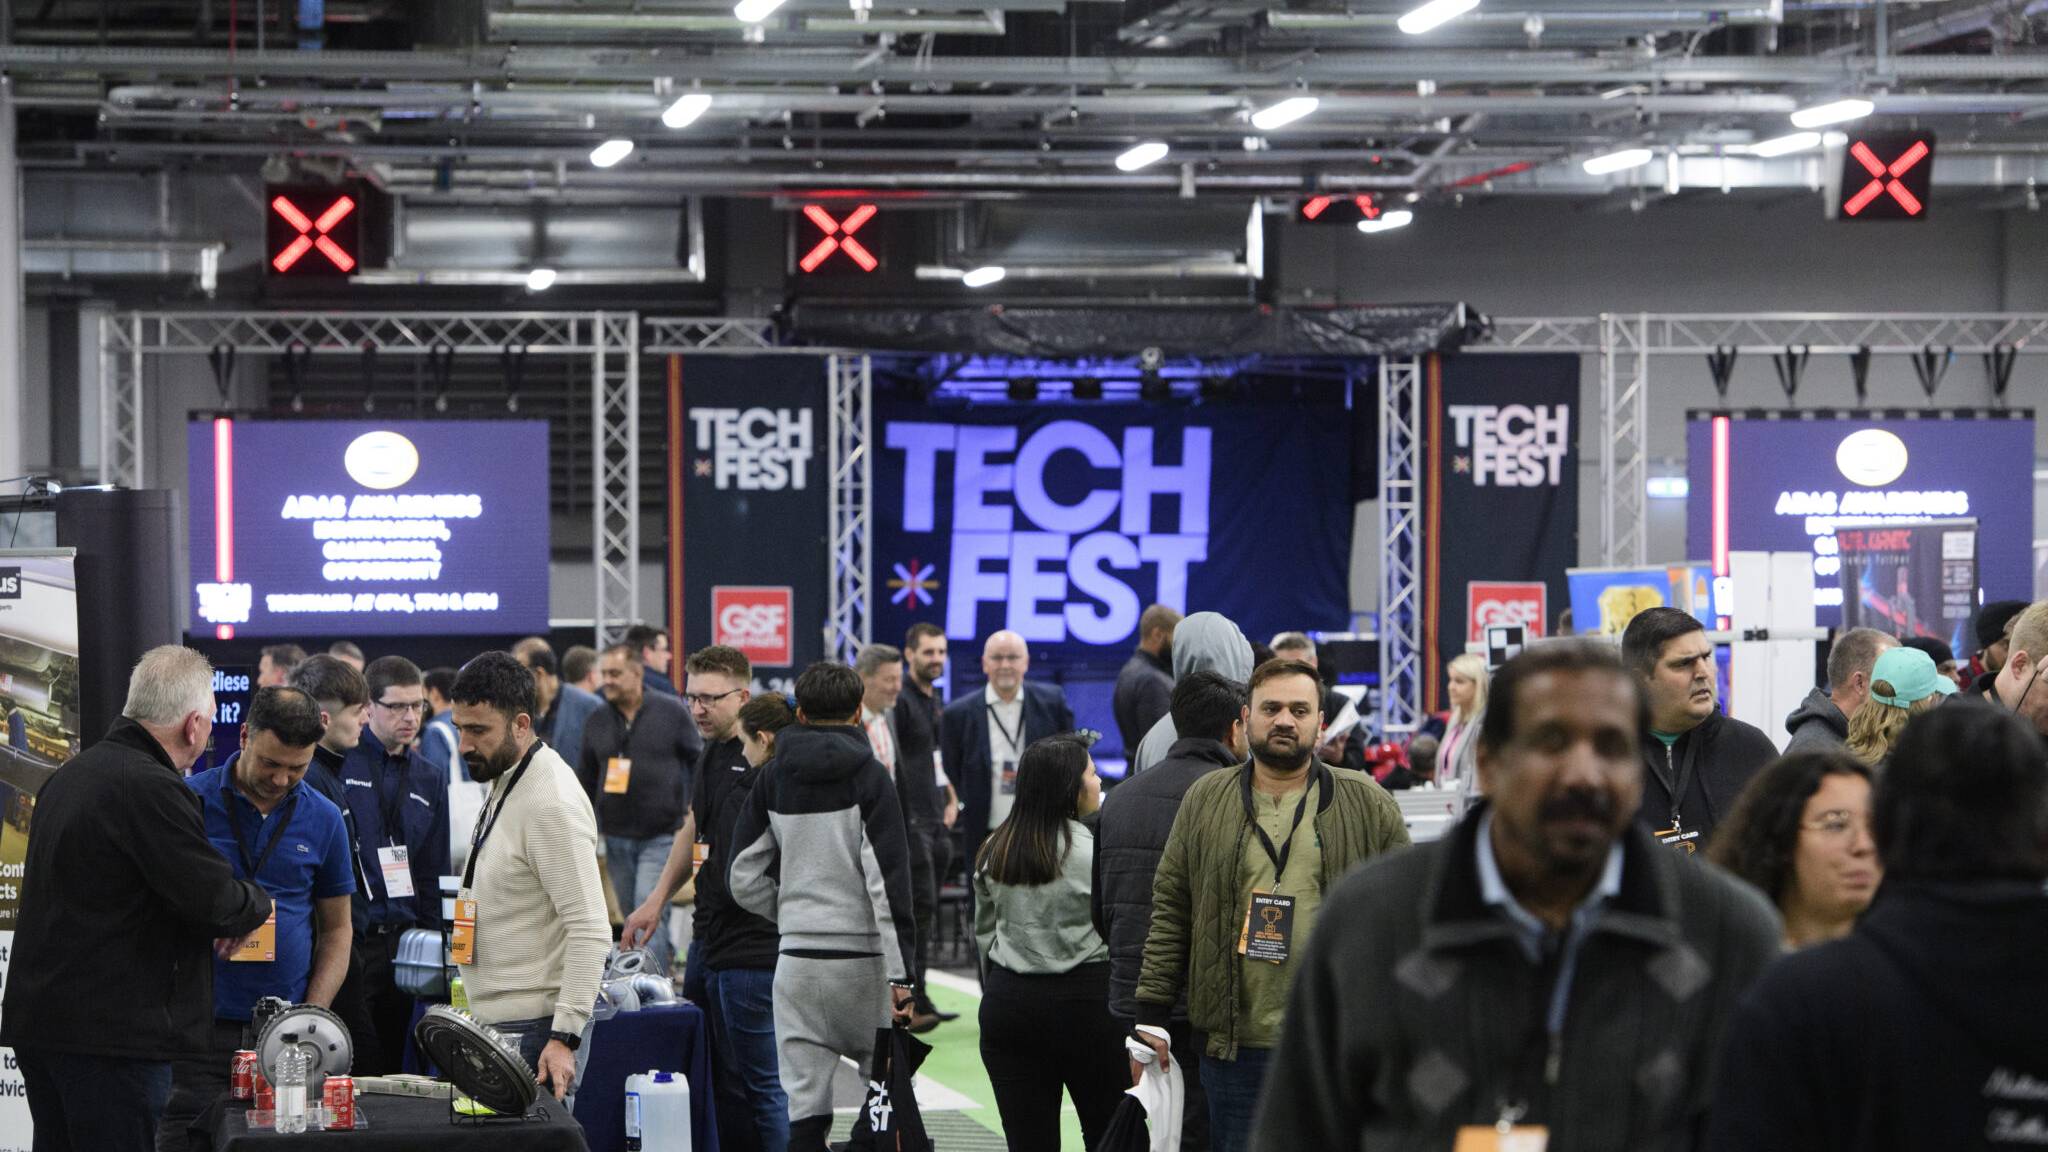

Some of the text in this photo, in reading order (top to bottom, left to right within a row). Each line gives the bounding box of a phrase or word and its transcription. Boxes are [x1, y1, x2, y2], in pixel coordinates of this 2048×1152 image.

[689, 407, 812, 450] TECH
[1450, 404, 1568, 447] TECH
[715, 447, 812, 491] FEST
[886, 420, 1212, 534] TECH
[1473, 444, 1567, 487] FEST
[945, 532, 1208, 645] FEST
[721, 604, 785, 634] GSF
[1476, 600, 1538, 628] GSF
[221, 702, 240, 723] it?
